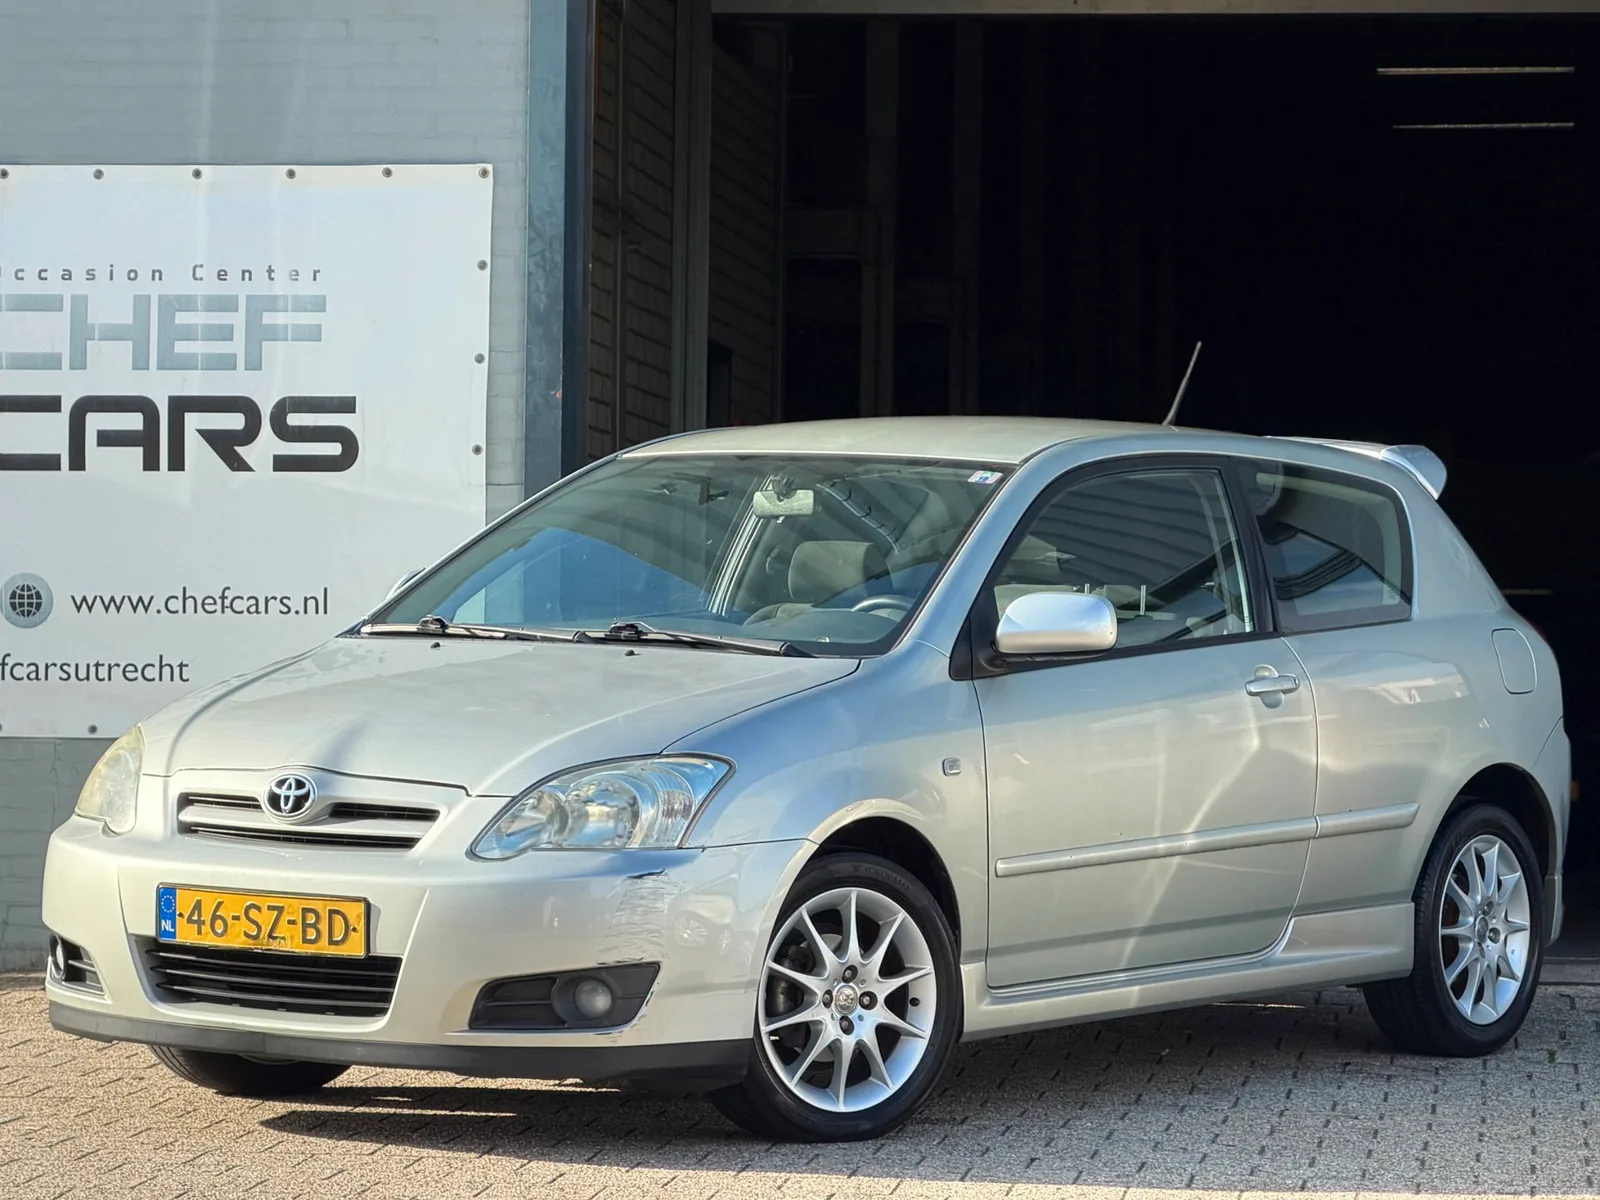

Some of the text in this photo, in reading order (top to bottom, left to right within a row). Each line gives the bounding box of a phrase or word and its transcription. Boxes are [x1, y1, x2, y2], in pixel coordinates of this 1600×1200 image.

[0, 264, 321, 281] ccasion Center
[0, 294, 326, 371] CHEF
[70, 586, 329, 615] www.chefcars.nl
[0, 653, 190, 682] fcarsutrecht
[161, 898, 350, 946] NL 46-SZ-BD
